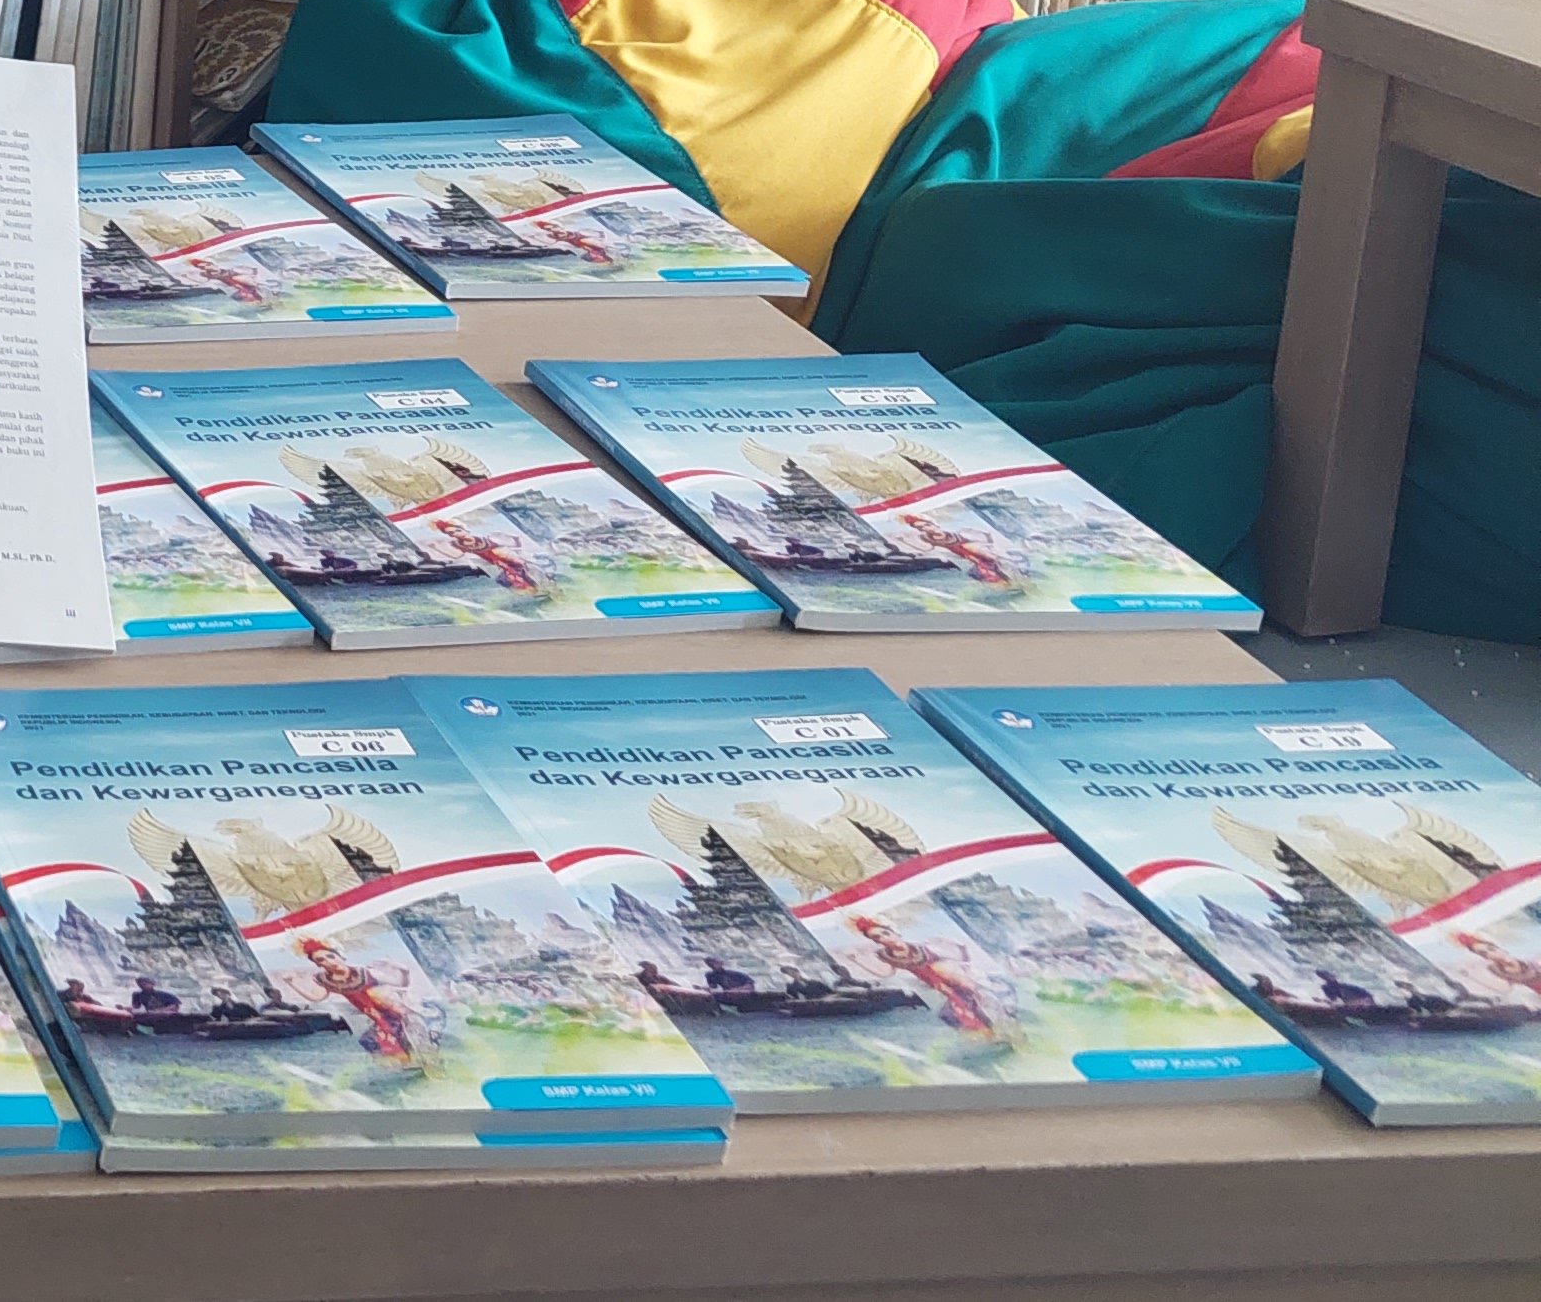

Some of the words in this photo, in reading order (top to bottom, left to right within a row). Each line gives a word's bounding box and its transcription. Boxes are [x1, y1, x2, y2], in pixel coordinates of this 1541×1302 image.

[175, 410, 336, 429] Pendidikan
[337, 403, 468, 422] Pancasila
[633, 404, 793, 420] Pendidikan
[797, 403, 938, 419] Pancasila
[186, 429, 241, 443] dan
[246, 419, 495, 443] Kewarganegaraan
[644, 420, 698, 435] dan
[704, 417, 963, 435] Kewarganegaraan
[515, 744, 714, 765] Pendidikan
[719, 739, 895, 761] Pancasila
[10, 756, 213, 779] Pendidikan
[221, 755, 400, 776] Pancasila
[528, 766, 597, 787] dan
[608, 761, 925, 786] Kewarganegaraan
[1058, 756, 1260, 779] Pendidikan
[1265, 754, 1442, 776] Pancasila
[15, 780, 83, 801] dan
[94, 776, 425, 801] Kewarganegaraan
[1083, 781, 1150, 799] dan
[1158, 774, 1481, 799] Kewarganegaraan
